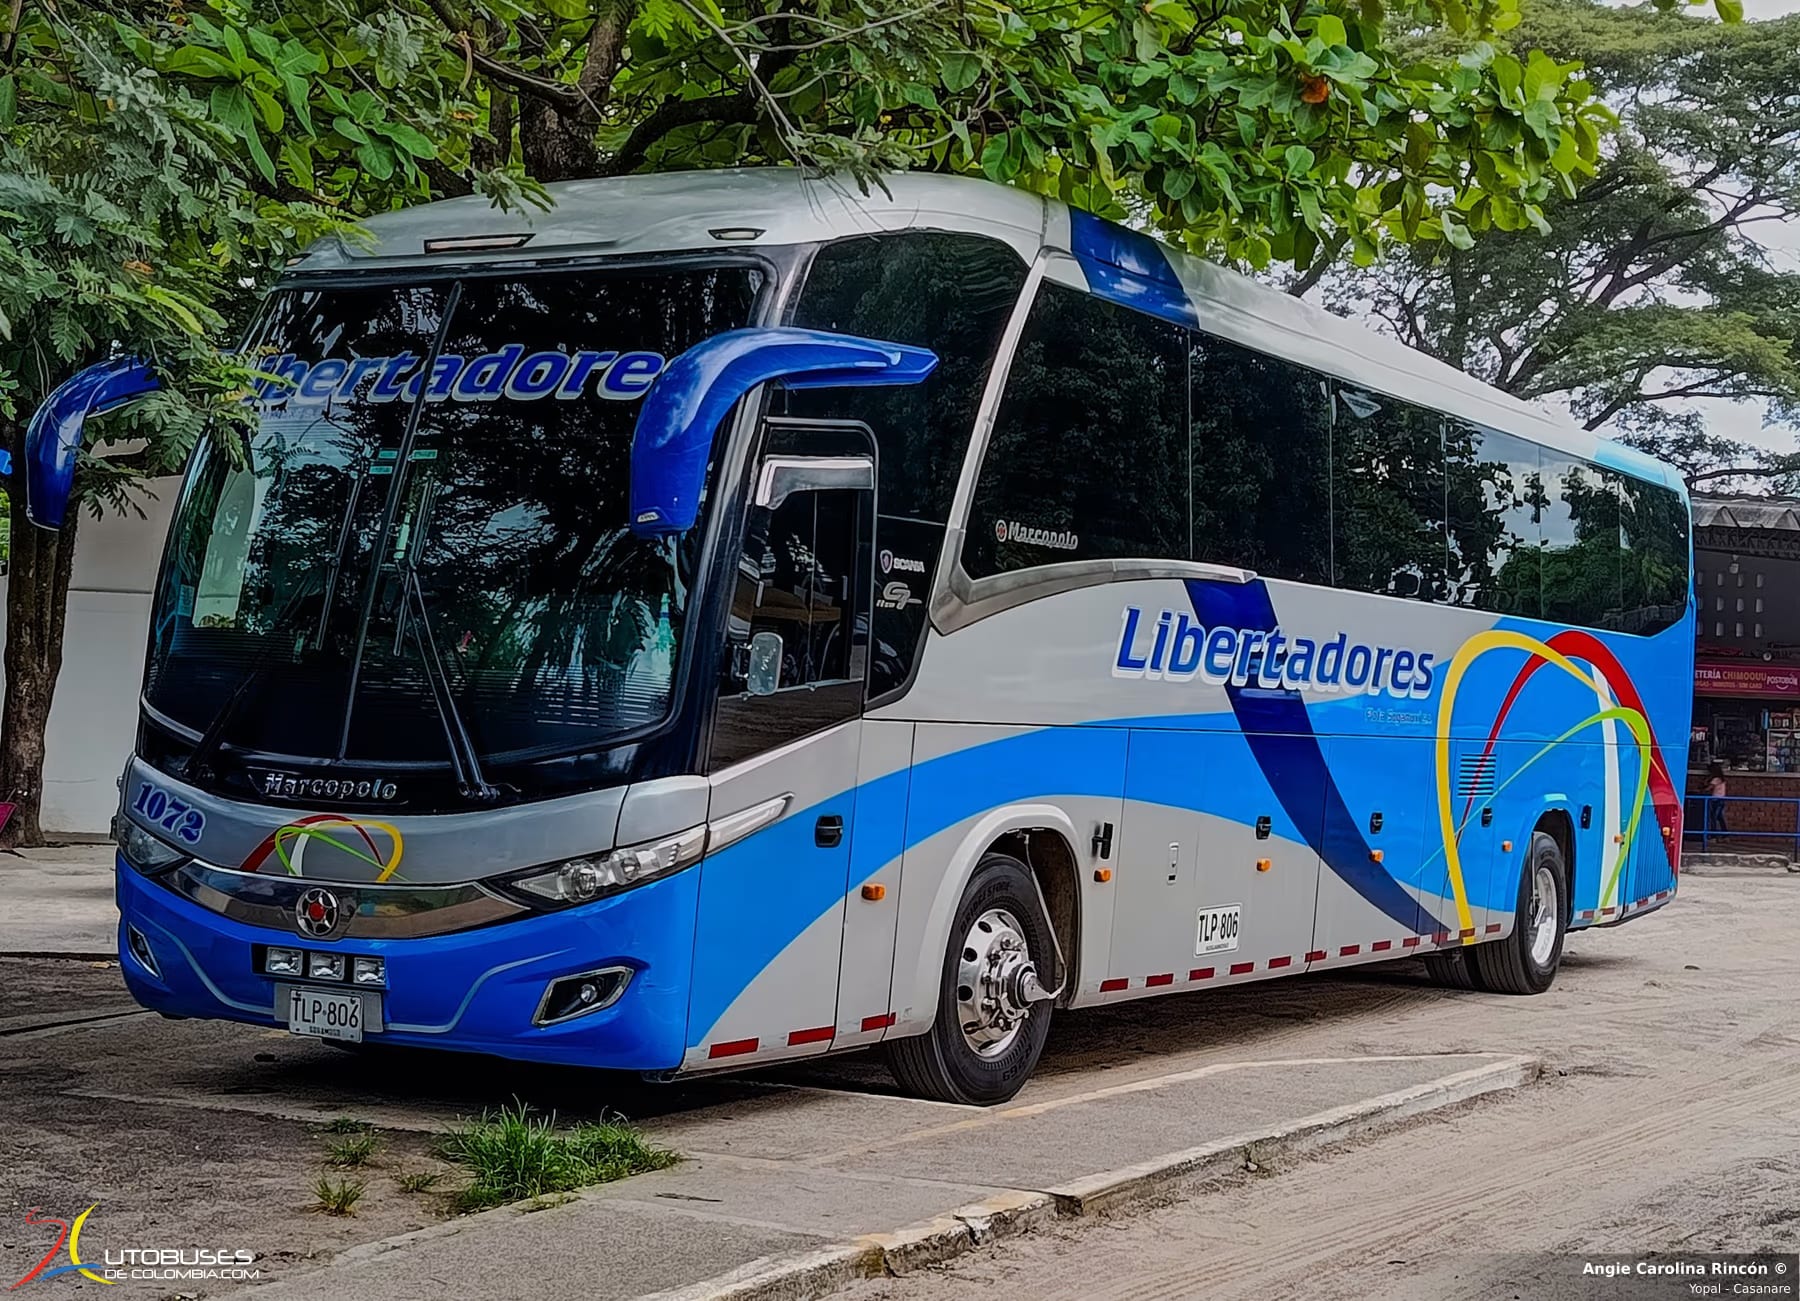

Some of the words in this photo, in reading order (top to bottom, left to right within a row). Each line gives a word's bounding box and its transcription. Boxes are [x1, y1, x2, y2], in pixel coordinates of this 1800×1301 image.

[1008, 521, 1079, 550] Marcopolo
[893, 557, 925, 573] SCANIA
[1111, 604, 1434, 699] Libertadores
[264, 772, 398, 800] Marcopolo
[131, 780, 206, 845] 1072
